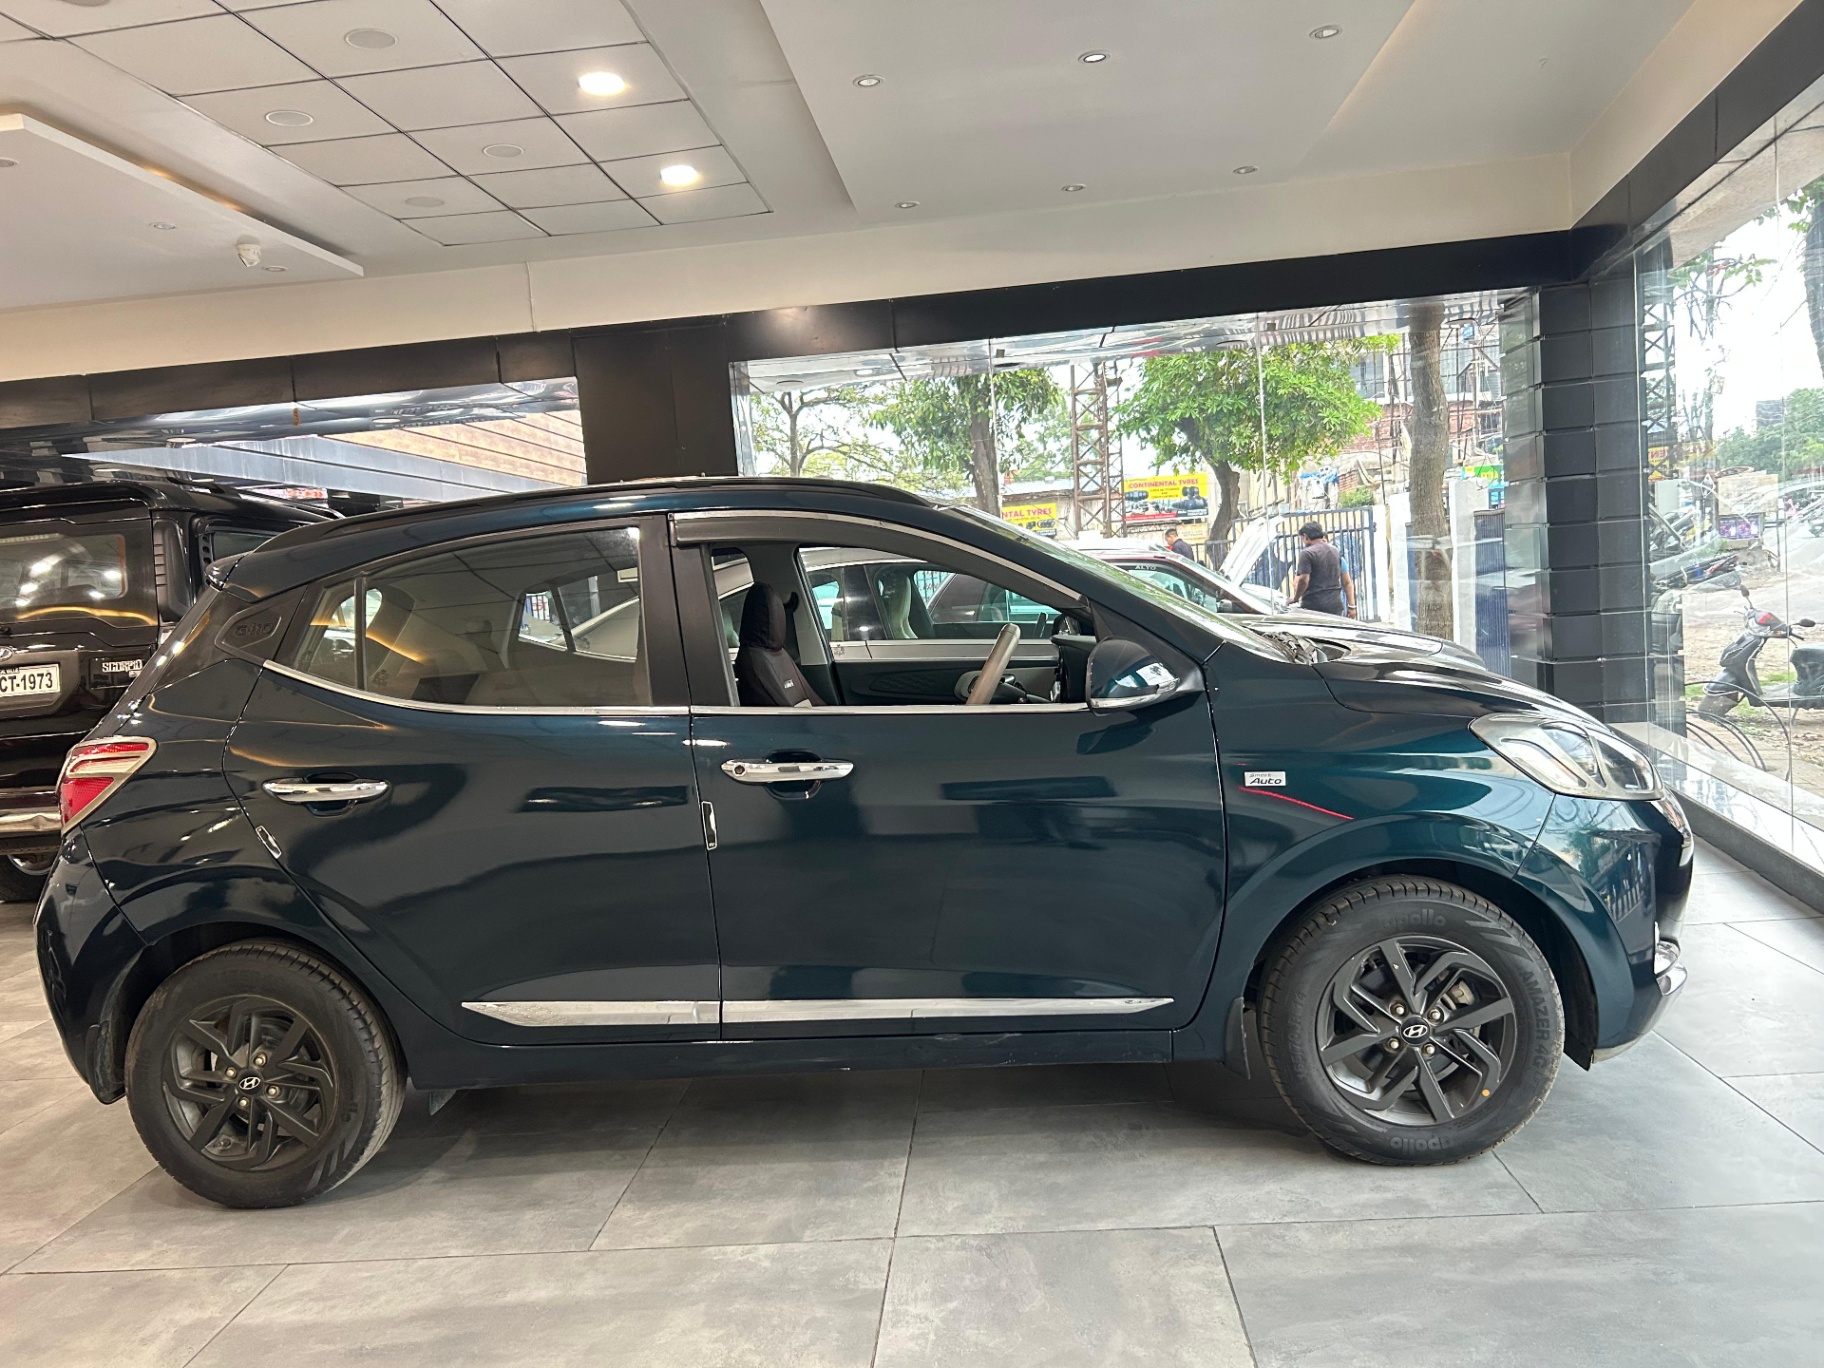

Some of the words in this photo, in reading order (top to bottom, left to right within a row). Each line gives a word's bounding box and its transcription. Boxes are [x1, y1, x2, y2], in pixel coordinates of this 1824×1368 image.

[1128, 480, 1177, 489] CONTINENTAL
[1027, 508, 1052, 516] TYRES
[102, 659, 143, 673] SCORPIO
[0, 672, 53, 692] CT-1973
[1250, 777, 1282, 785] Auto
[1519, 970, 1551, 1040] AMAZER
